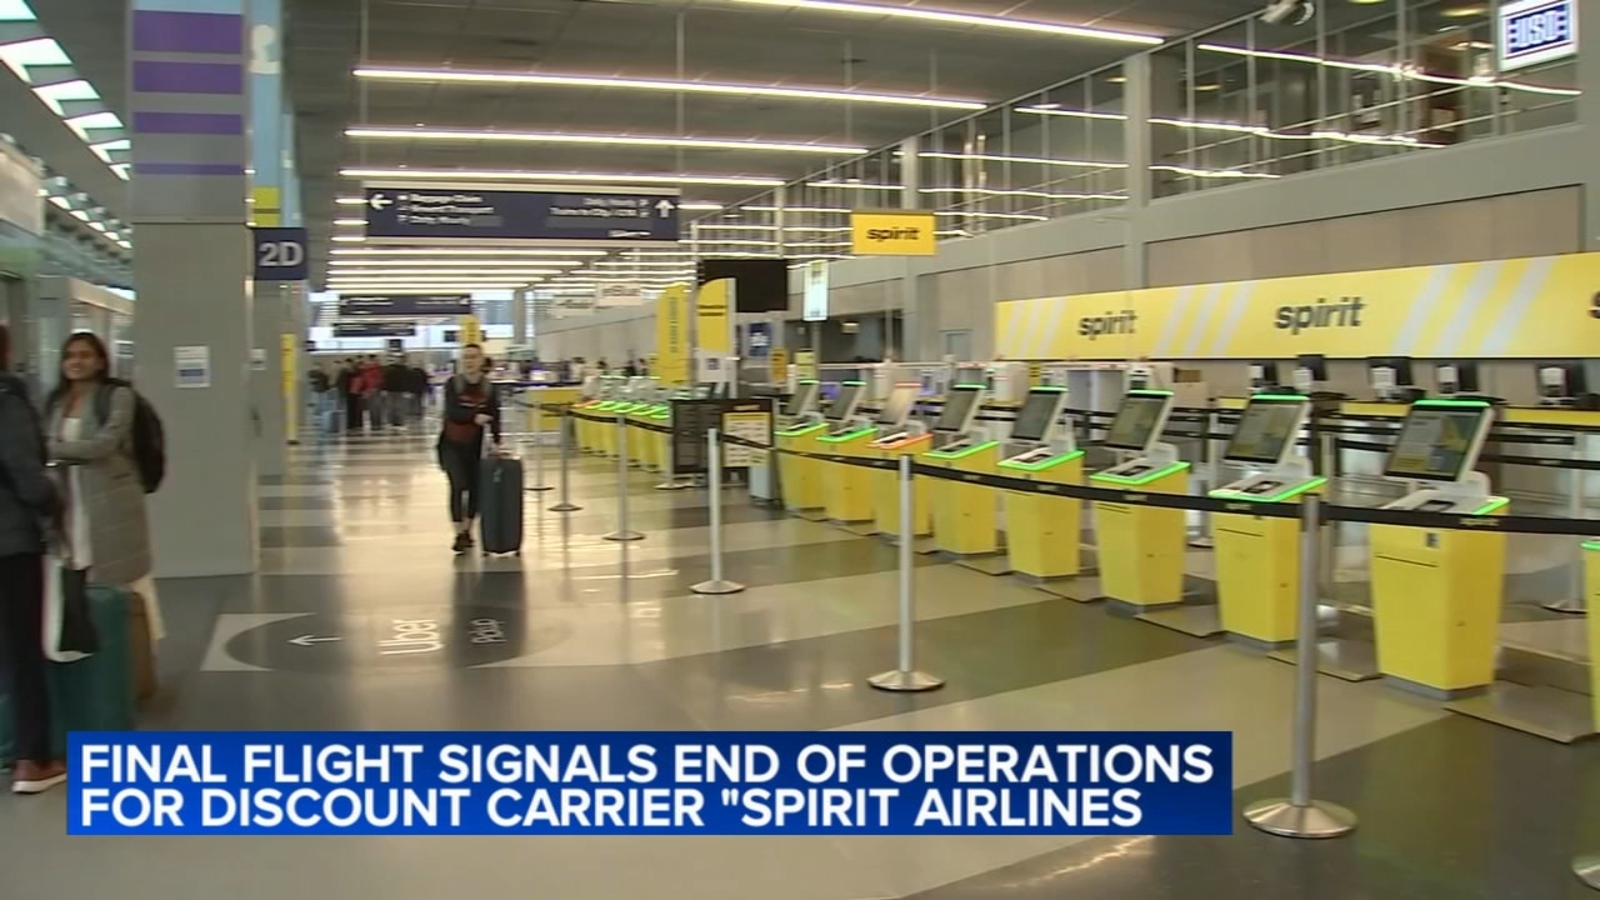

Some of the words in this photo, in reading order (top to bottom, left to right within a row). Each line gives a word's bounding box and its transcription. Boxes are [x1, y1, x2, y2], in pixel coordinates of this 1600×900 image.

[866, 226, 920, 243] spirit
[258, 241, 304, 268] 2D
[1078, 309, 1138, 340] spirit
[1274, 296, 1366, 335] spirit
[376, 618, 444, 656] Uber
